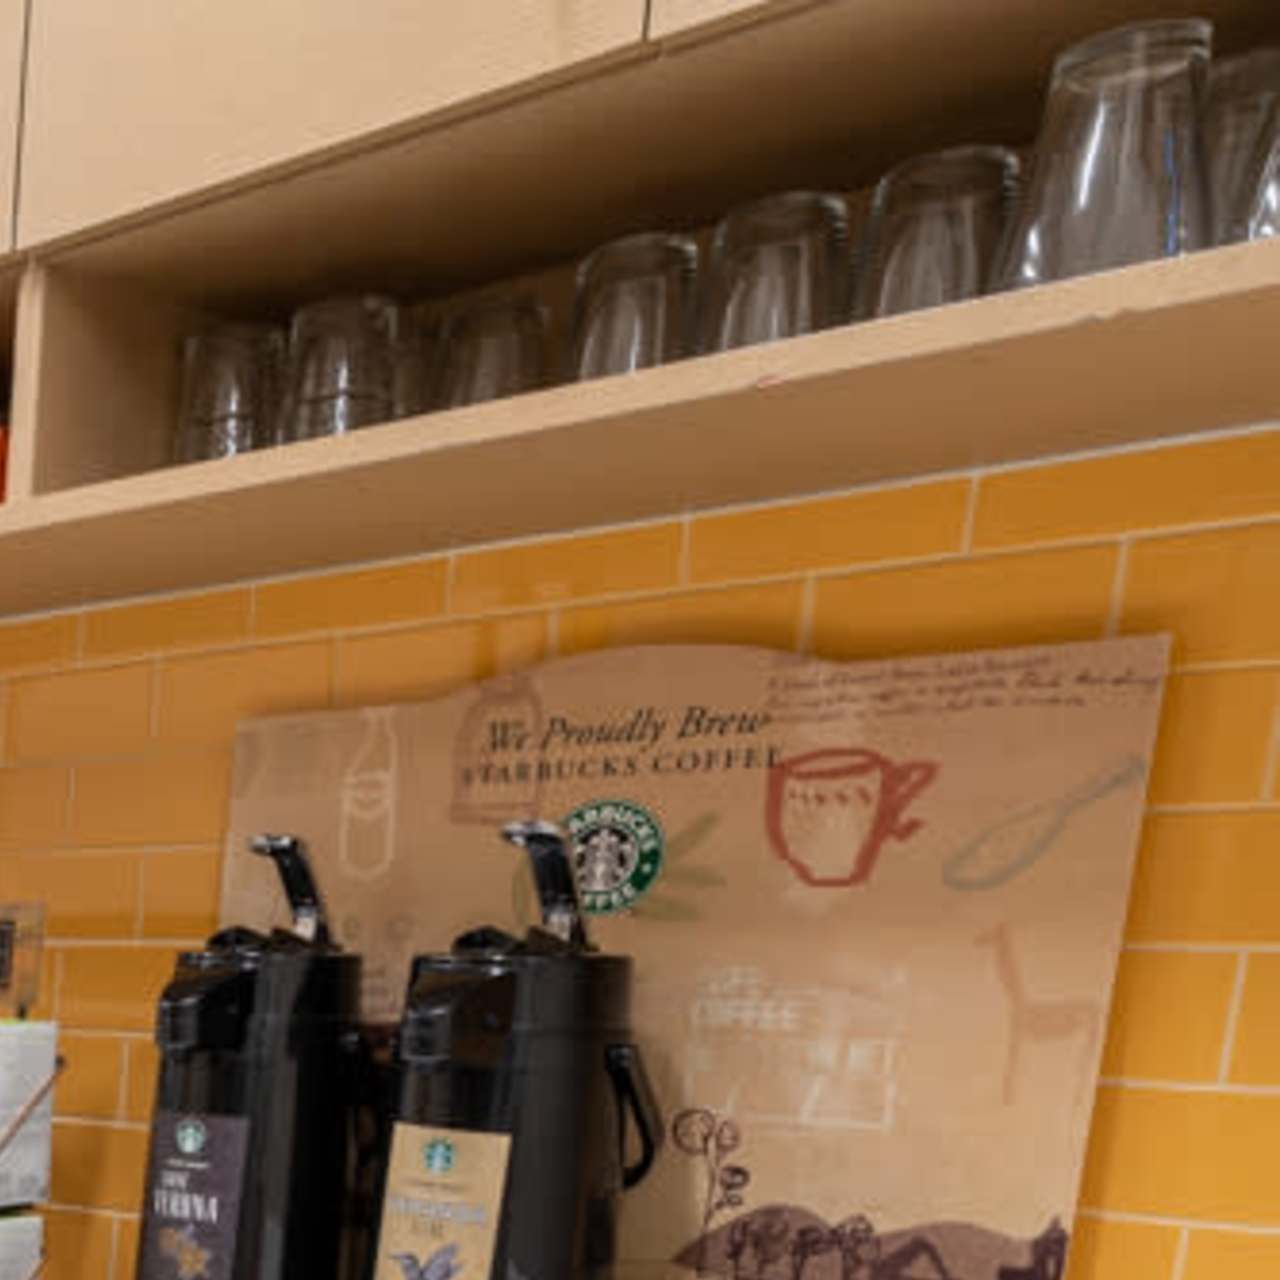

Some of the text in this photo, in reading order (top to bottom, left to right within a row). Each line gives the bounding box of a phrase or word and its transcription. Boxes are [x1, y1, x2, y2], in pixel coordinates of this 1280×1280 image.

[490, 720, 529, 751] We
[543, 706, 666, 751] Proudly
[677, 704, 773, 740] Brew
[461, 746, 782, 785] STARBUCKS COFFEE
